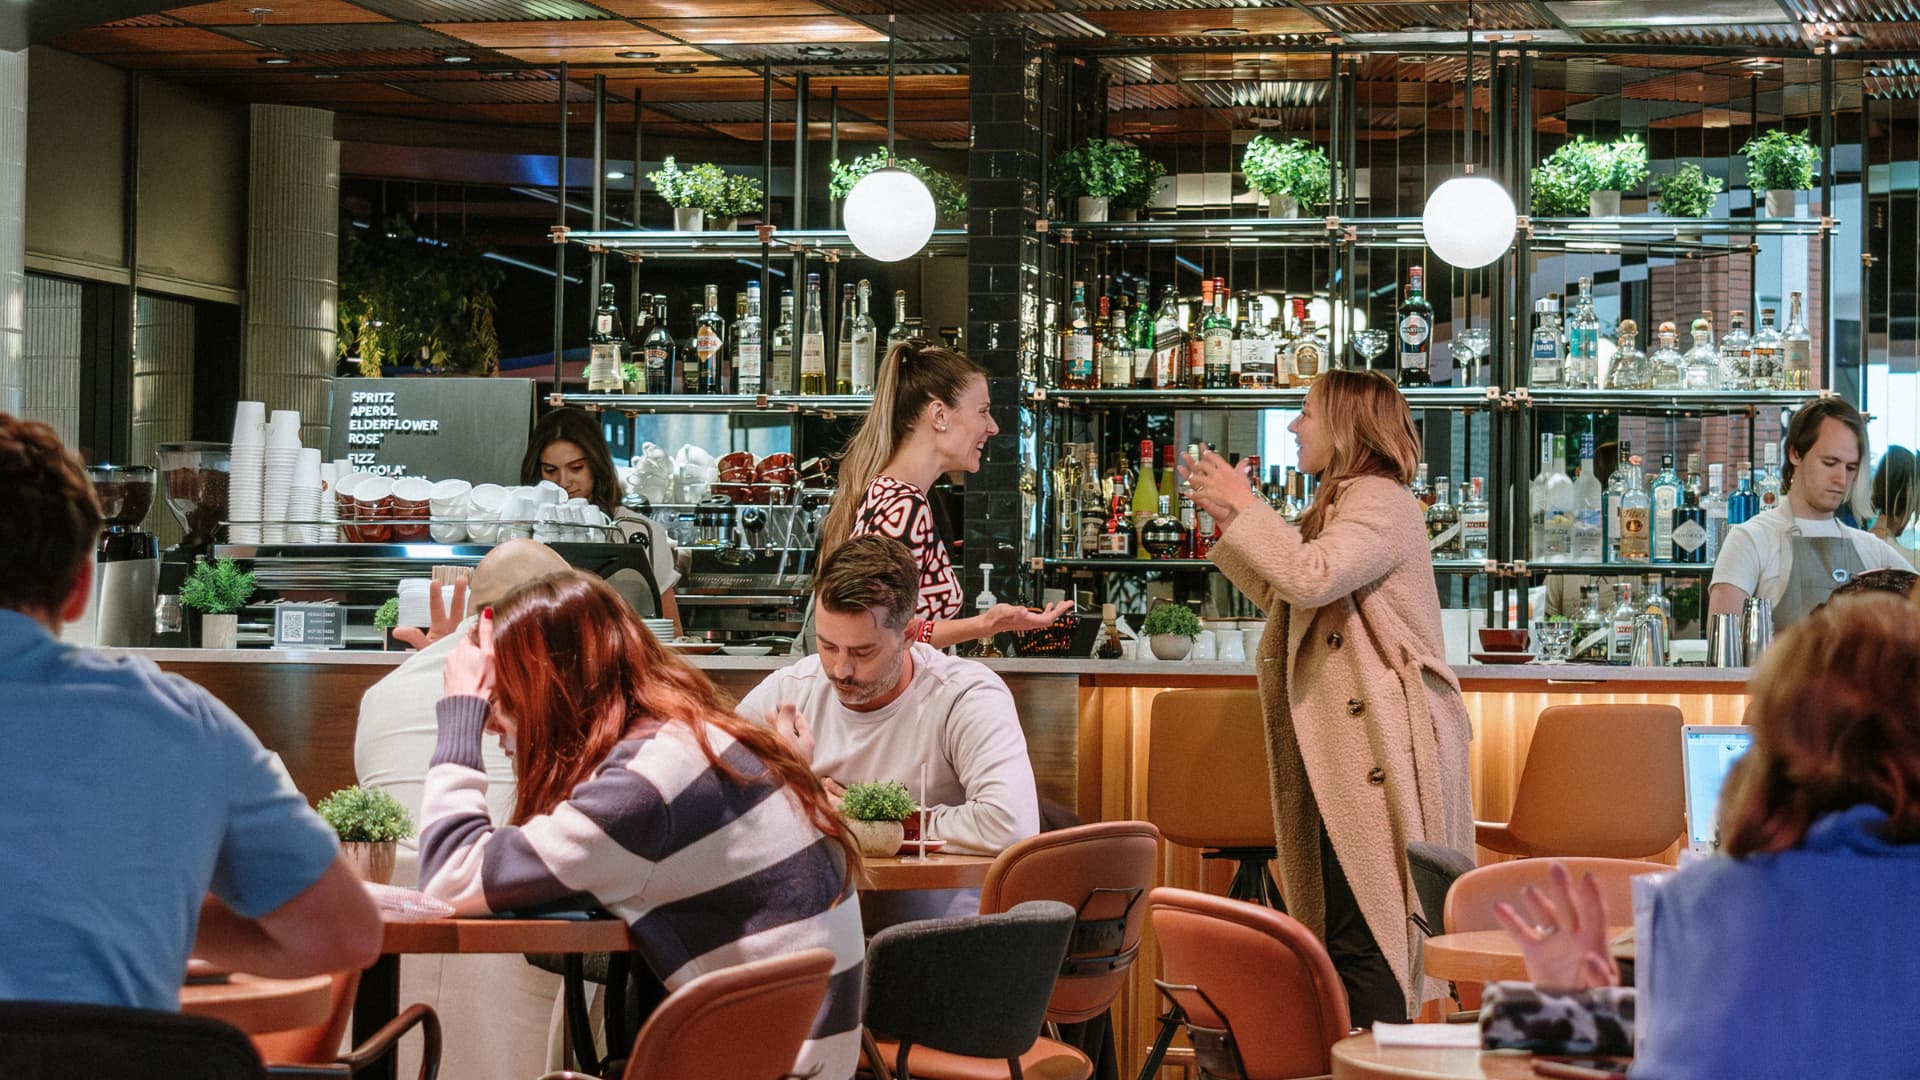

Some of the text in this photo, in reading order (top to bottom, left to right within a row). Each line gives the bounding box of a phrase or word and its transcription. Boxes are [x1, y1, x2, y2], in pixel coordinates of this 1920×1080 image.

[352, 392, 395, 403] SPRITZ
[350, 405, 397, 417] APEROL
[348, 419, 439, 431] ELDERFLOWER
[347, 453, 376, 464] FIZZ
[352, 464, 407, 476] RAGOLA
